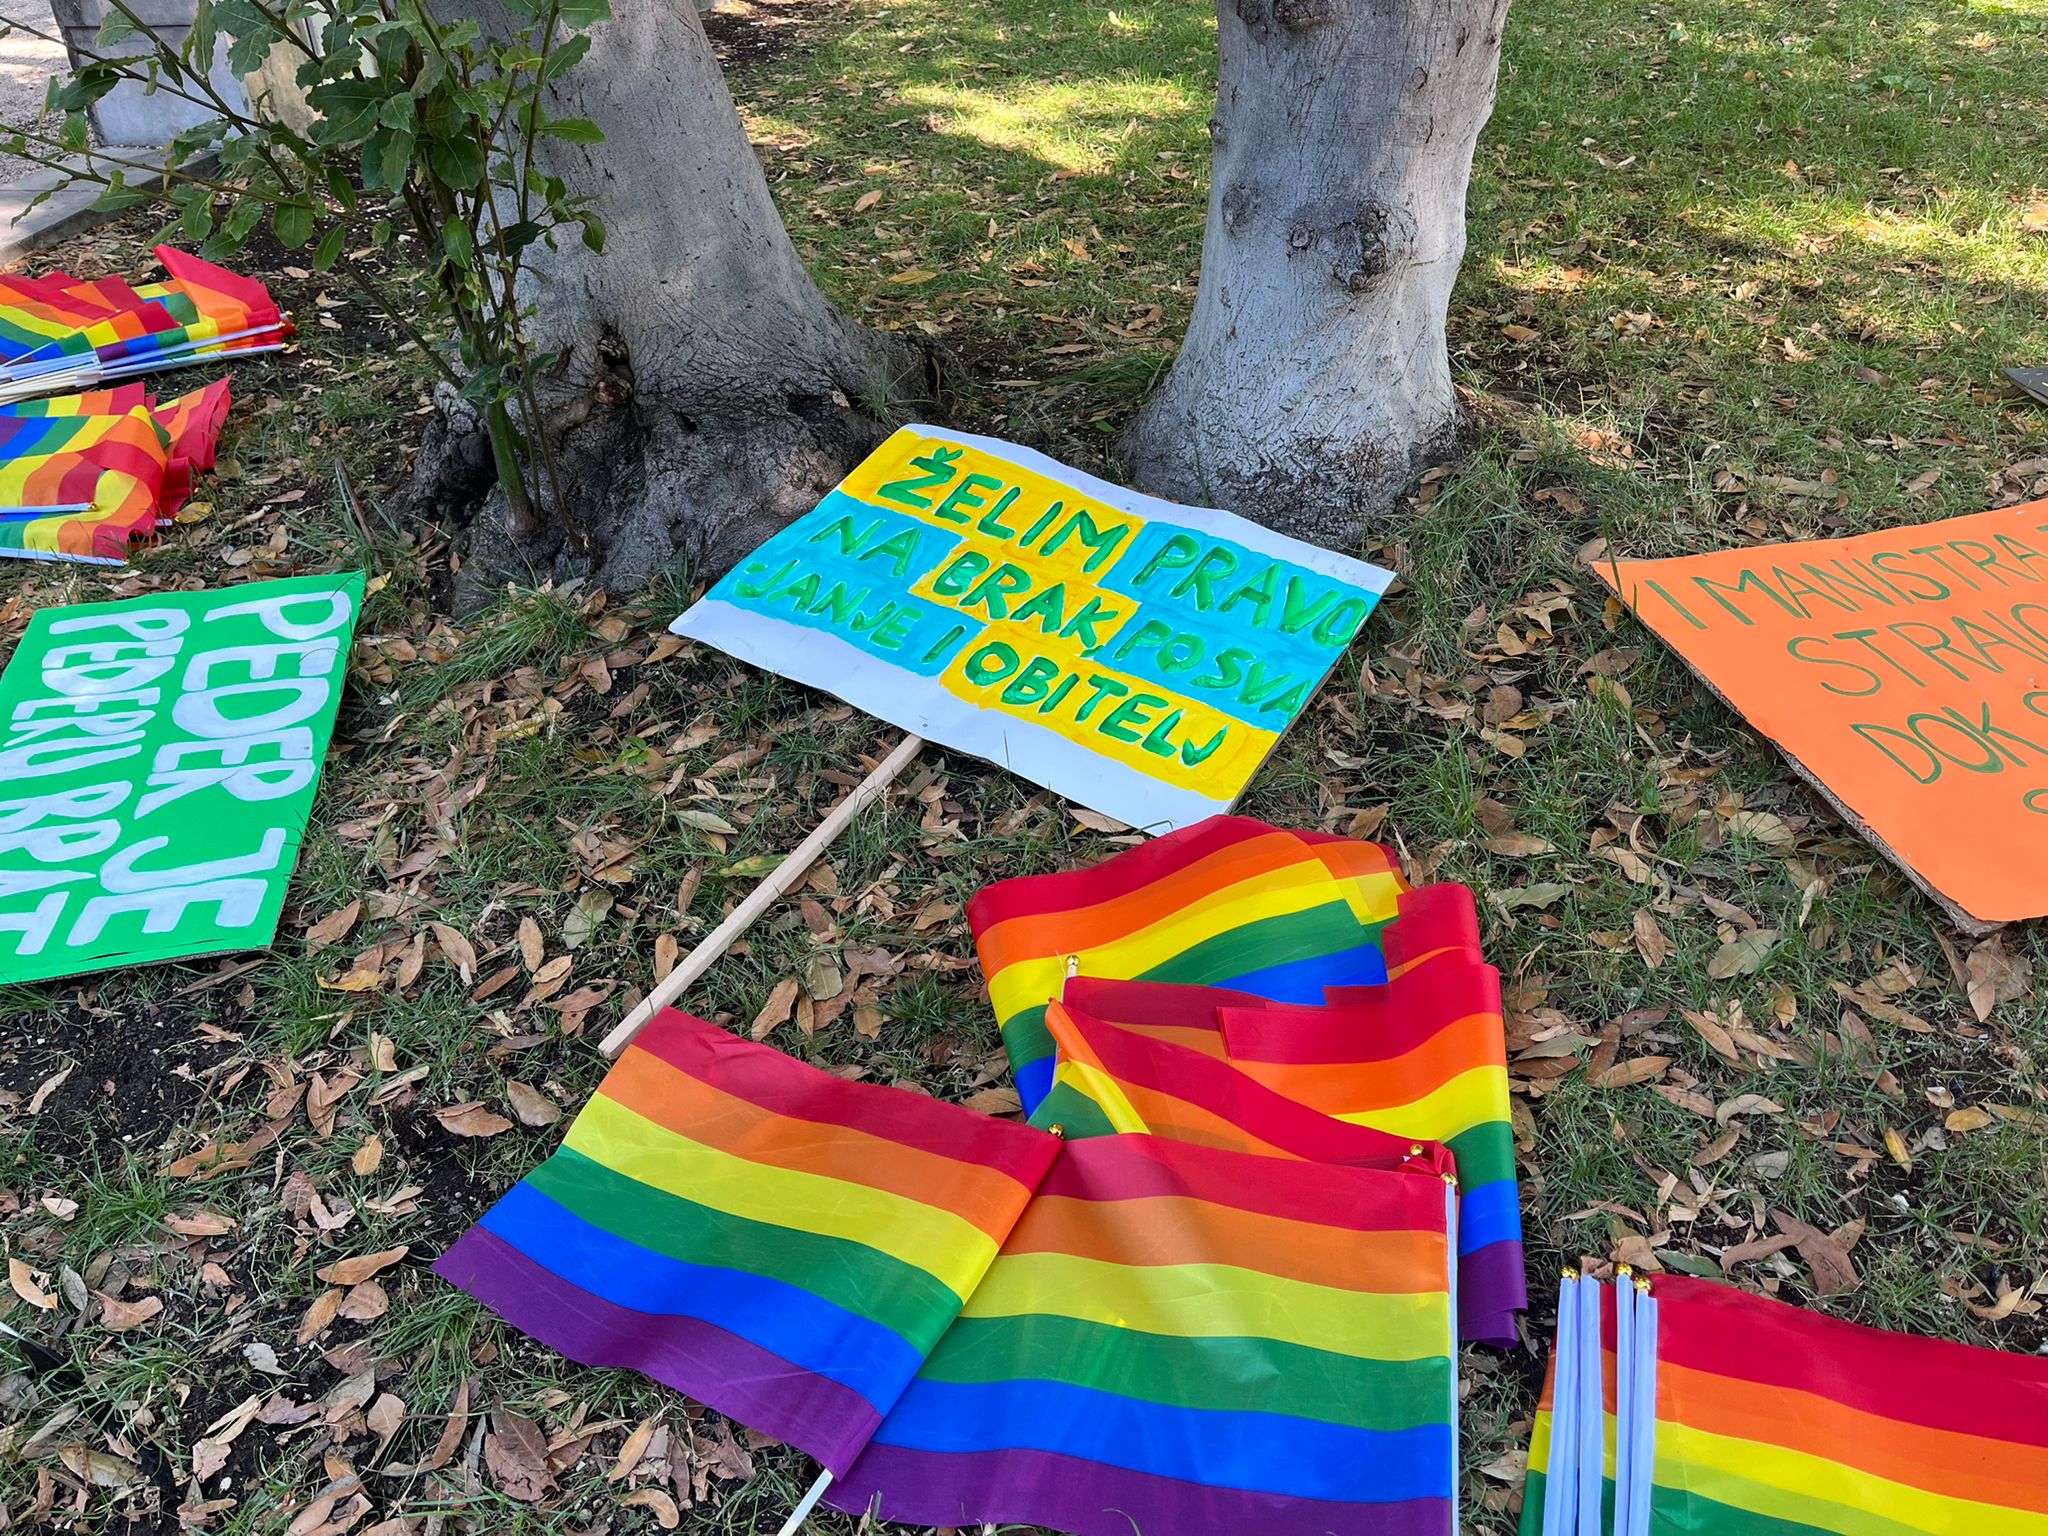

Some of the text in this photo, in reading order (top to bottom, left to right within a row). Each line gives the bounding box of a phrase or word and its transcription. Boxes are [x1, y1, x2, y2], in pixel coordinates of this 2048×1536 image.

[807, 514, 921, 577] NA
[876, 446, 1368, 648] ŽELIM PRAVO
[1645, 579, 1708, 630] I
[0, 608, 191, 781] PEDERU
[921, 624, 967, 664] I
[963, 640, 1229, 768] OBITELJ
[1850, 700, 2048, 785] DOK
[66, 590, 352, 947] PEDER JE
